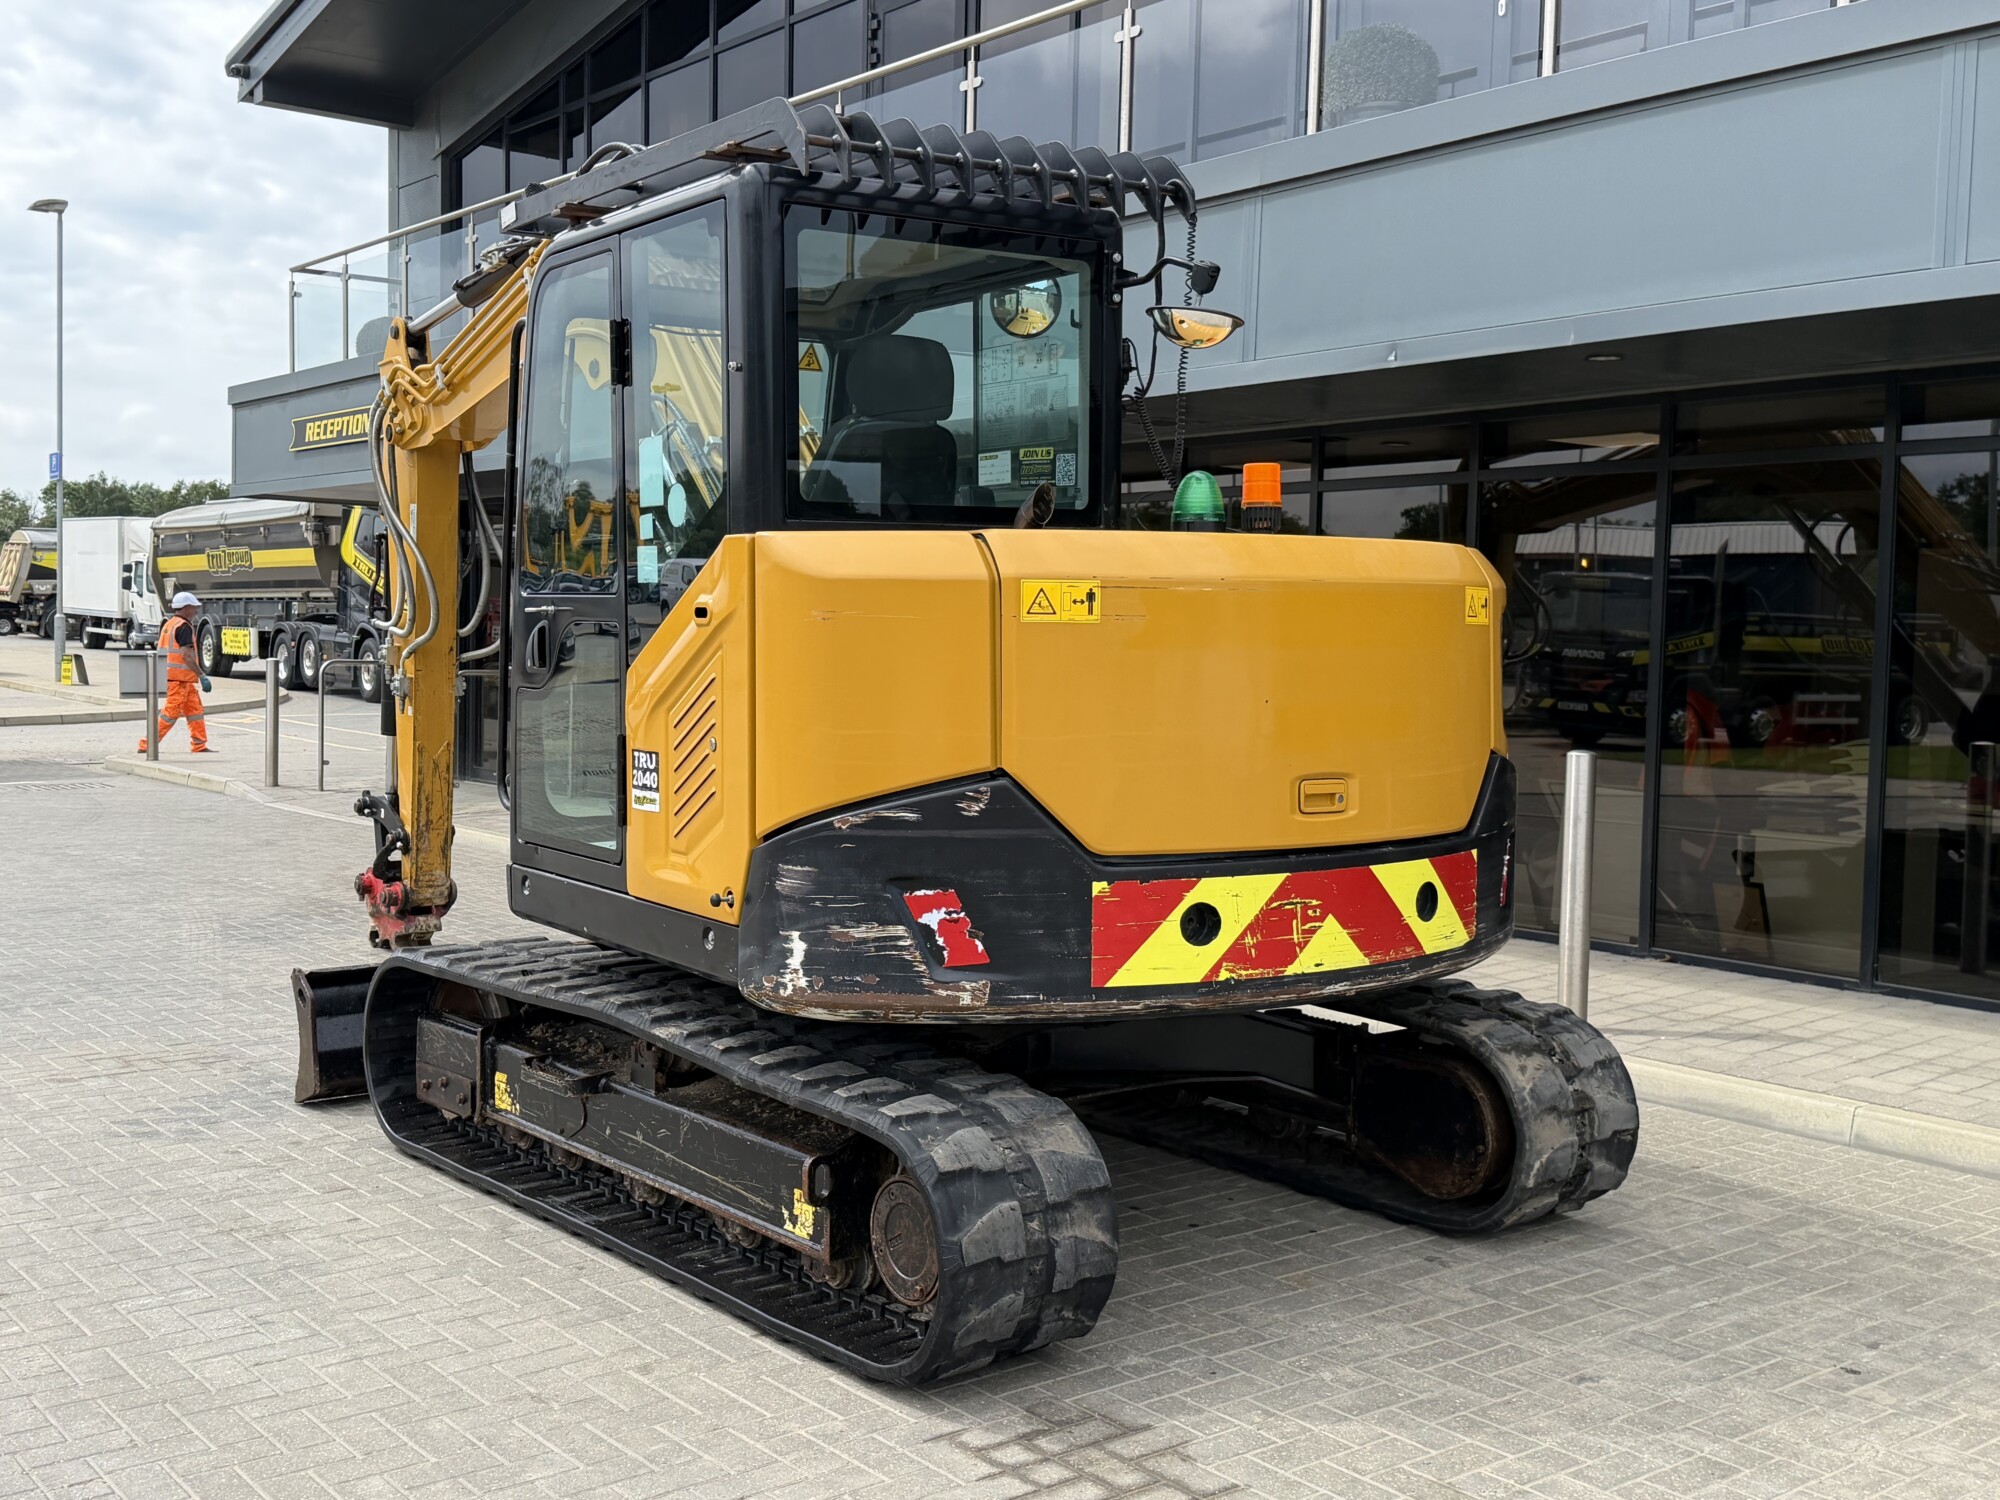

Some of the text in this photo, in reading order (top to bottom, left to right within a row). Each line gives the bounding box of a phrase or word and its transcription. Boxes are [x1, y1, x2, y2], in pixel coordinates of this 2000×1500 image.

[305, 413, 369, 442] RECEPTION
[1021, 449, 1052, 459] JOIN US
[633, 751, 656, 769] TRU
[632, 769, 658, 789] 2040
